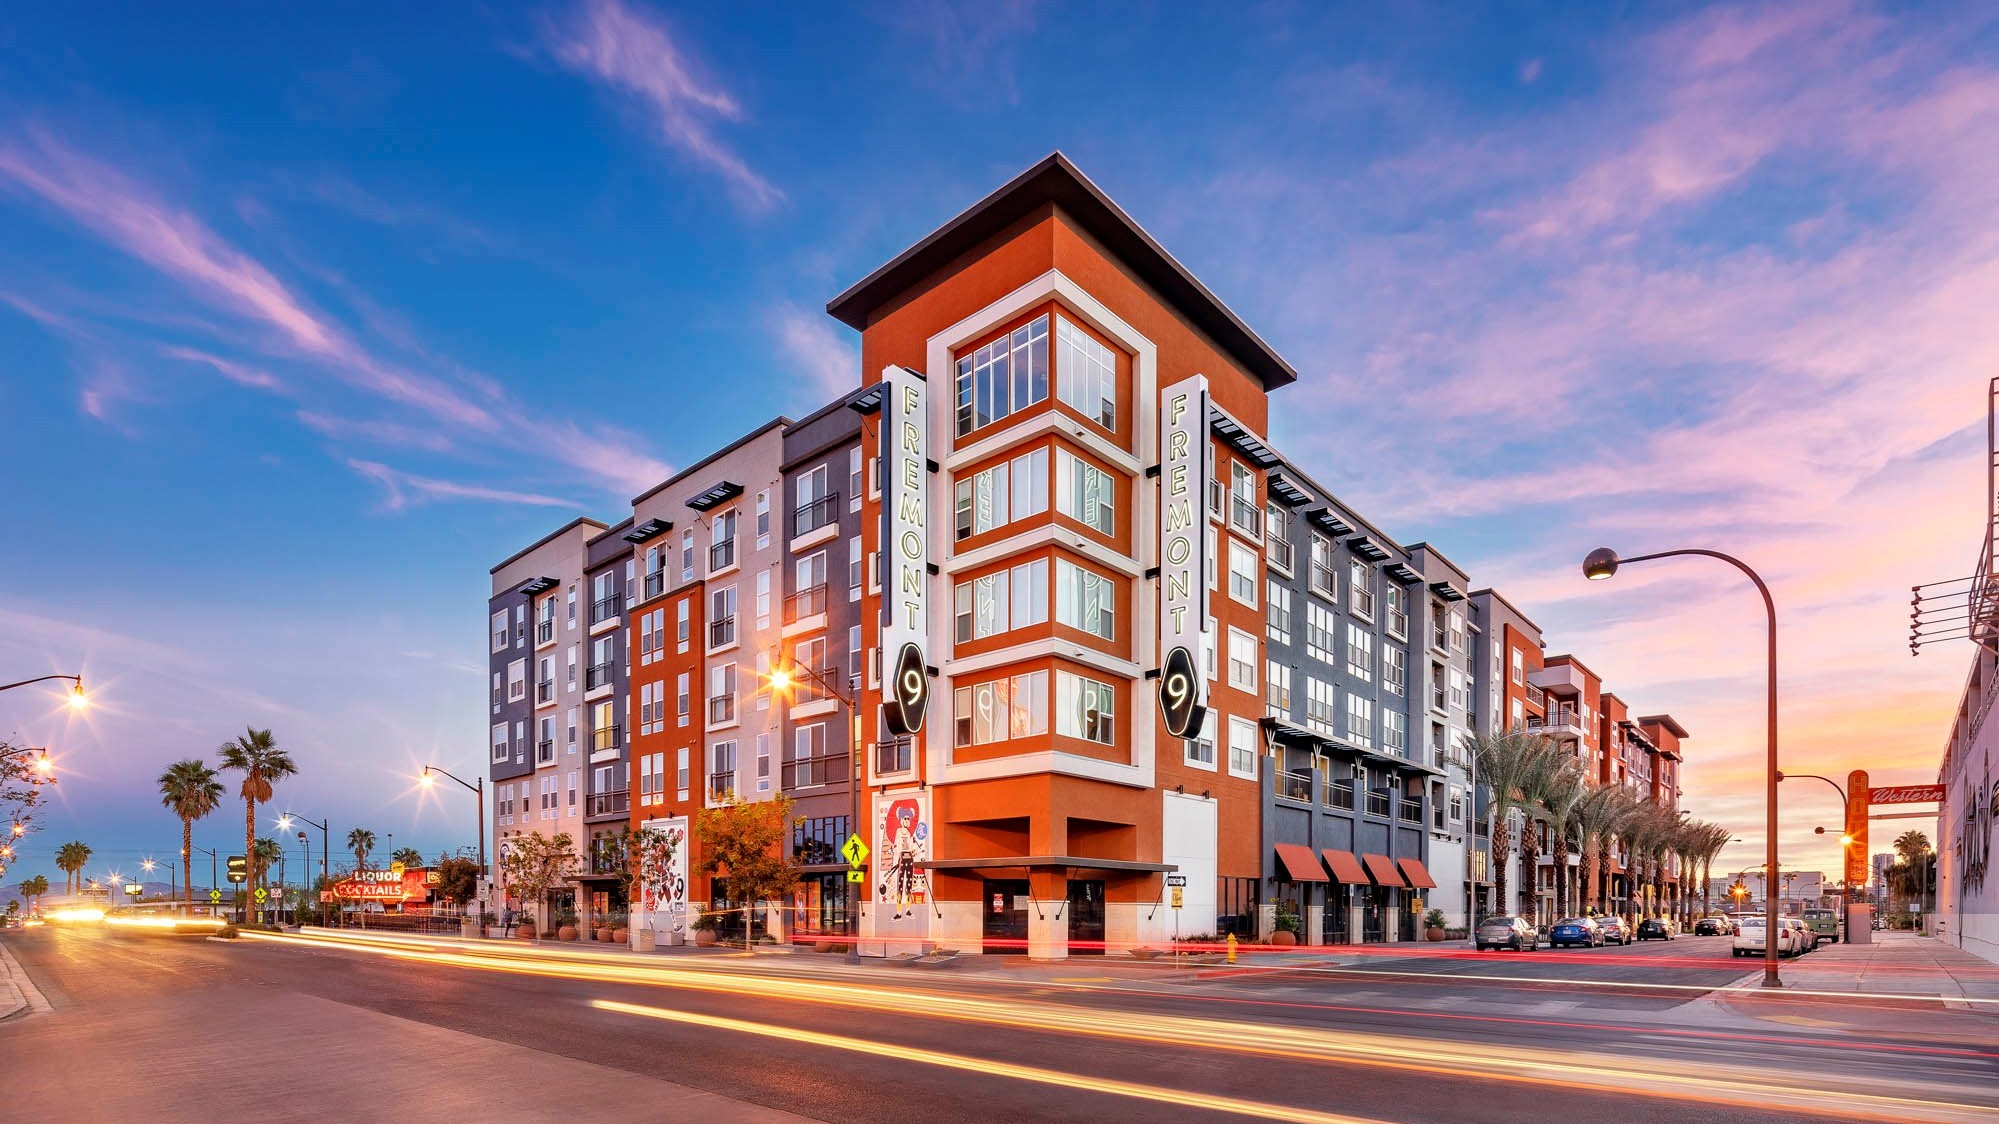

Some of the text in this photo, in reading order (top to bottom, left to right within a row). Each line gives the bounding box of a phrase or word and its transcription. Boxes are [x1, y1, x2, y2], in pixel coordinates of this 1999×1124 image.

[900, 386, 923, 630] FREMONT
[1166, 394, 1191, 634] FREMONT
[904, 670, 922, 706] 9
[1168, 673, 1188, 710] 9
[1872, 788, 1944, 803] Western
[339, 884, 402, 895] COCKTAILS
[354, 871, 401, 881] LIQUOR
[676, 878, 684, 900] 9
